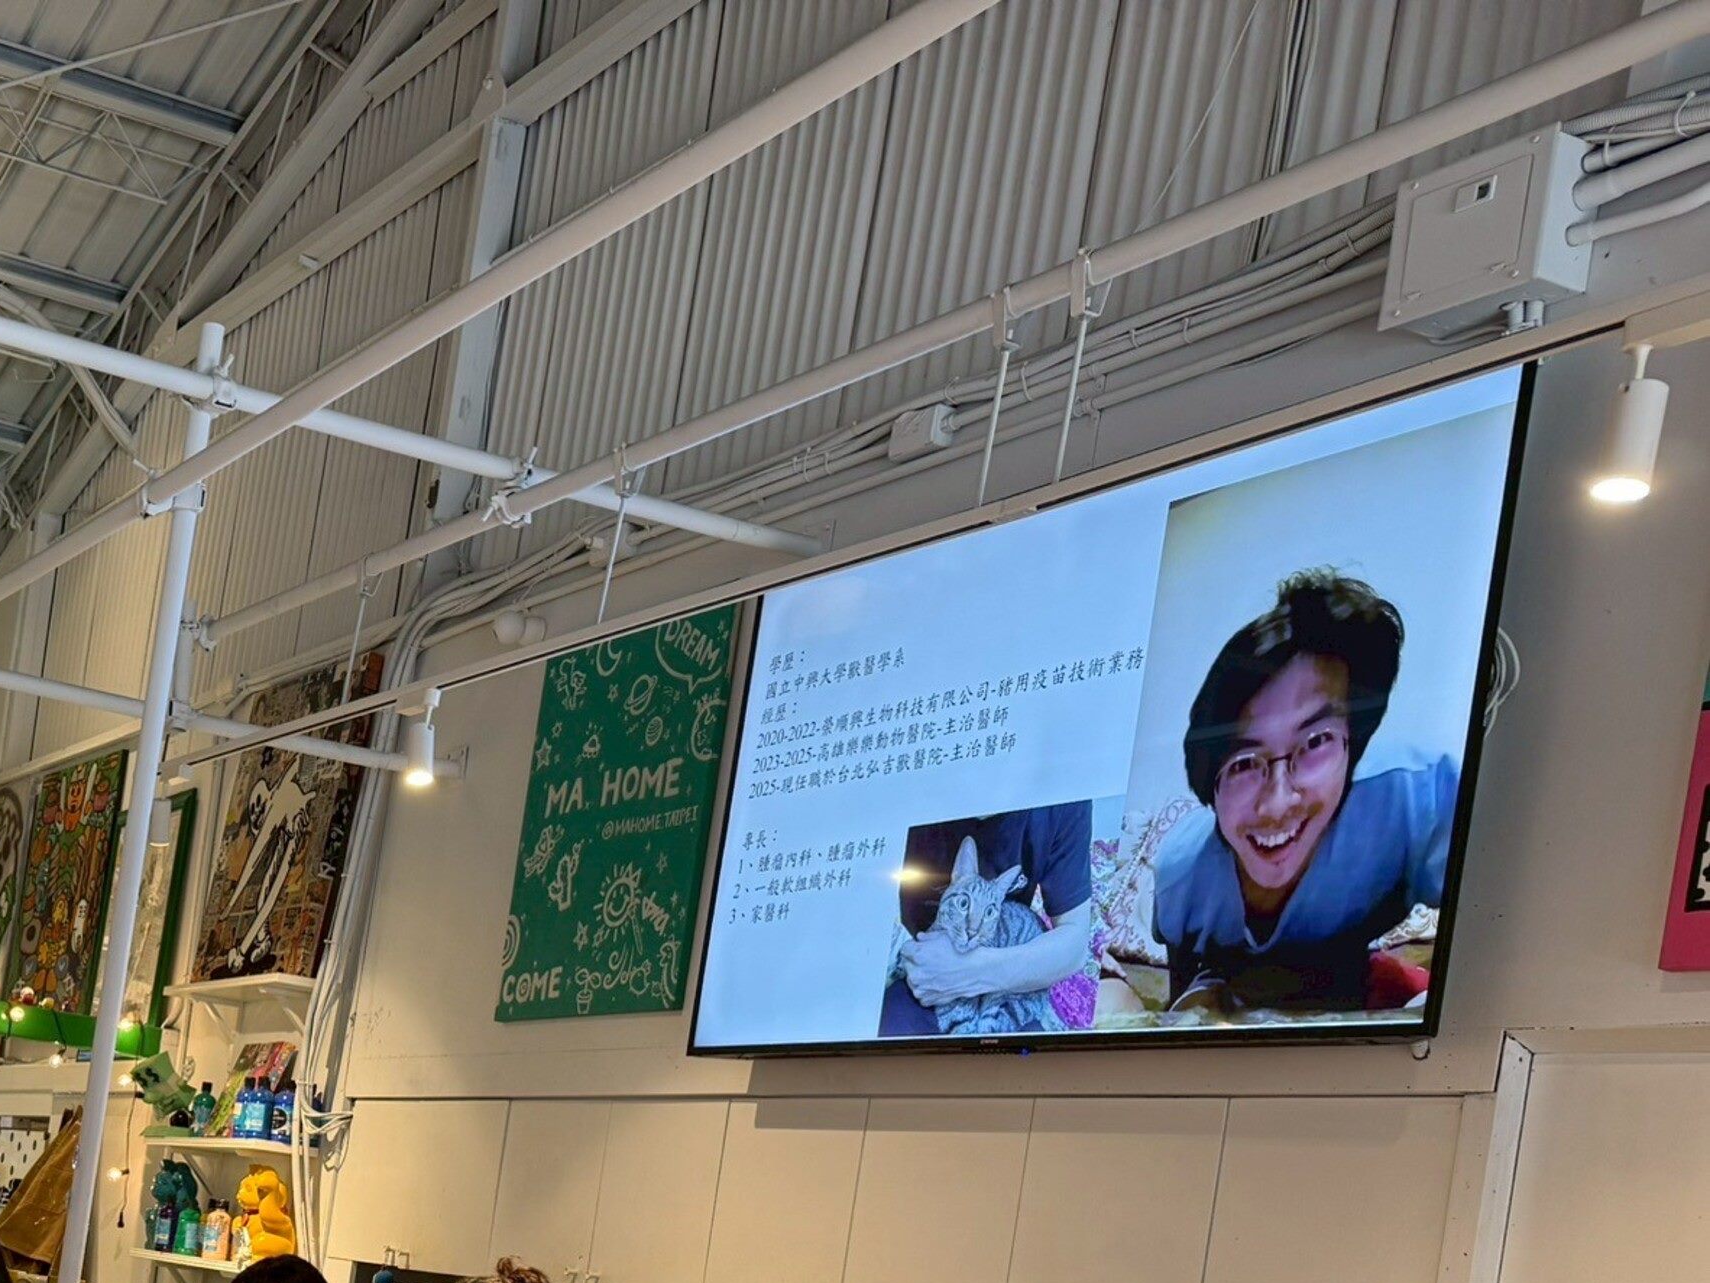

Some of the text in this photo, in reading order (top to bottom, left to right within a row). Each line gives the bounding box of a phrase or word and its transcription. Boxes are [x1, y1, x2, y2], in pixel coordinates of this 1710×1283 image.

[664, 619, 720, 671] DREAM
[545, 757, 684, 819] MA HOME
[503, 966, 563, 1003] COME
